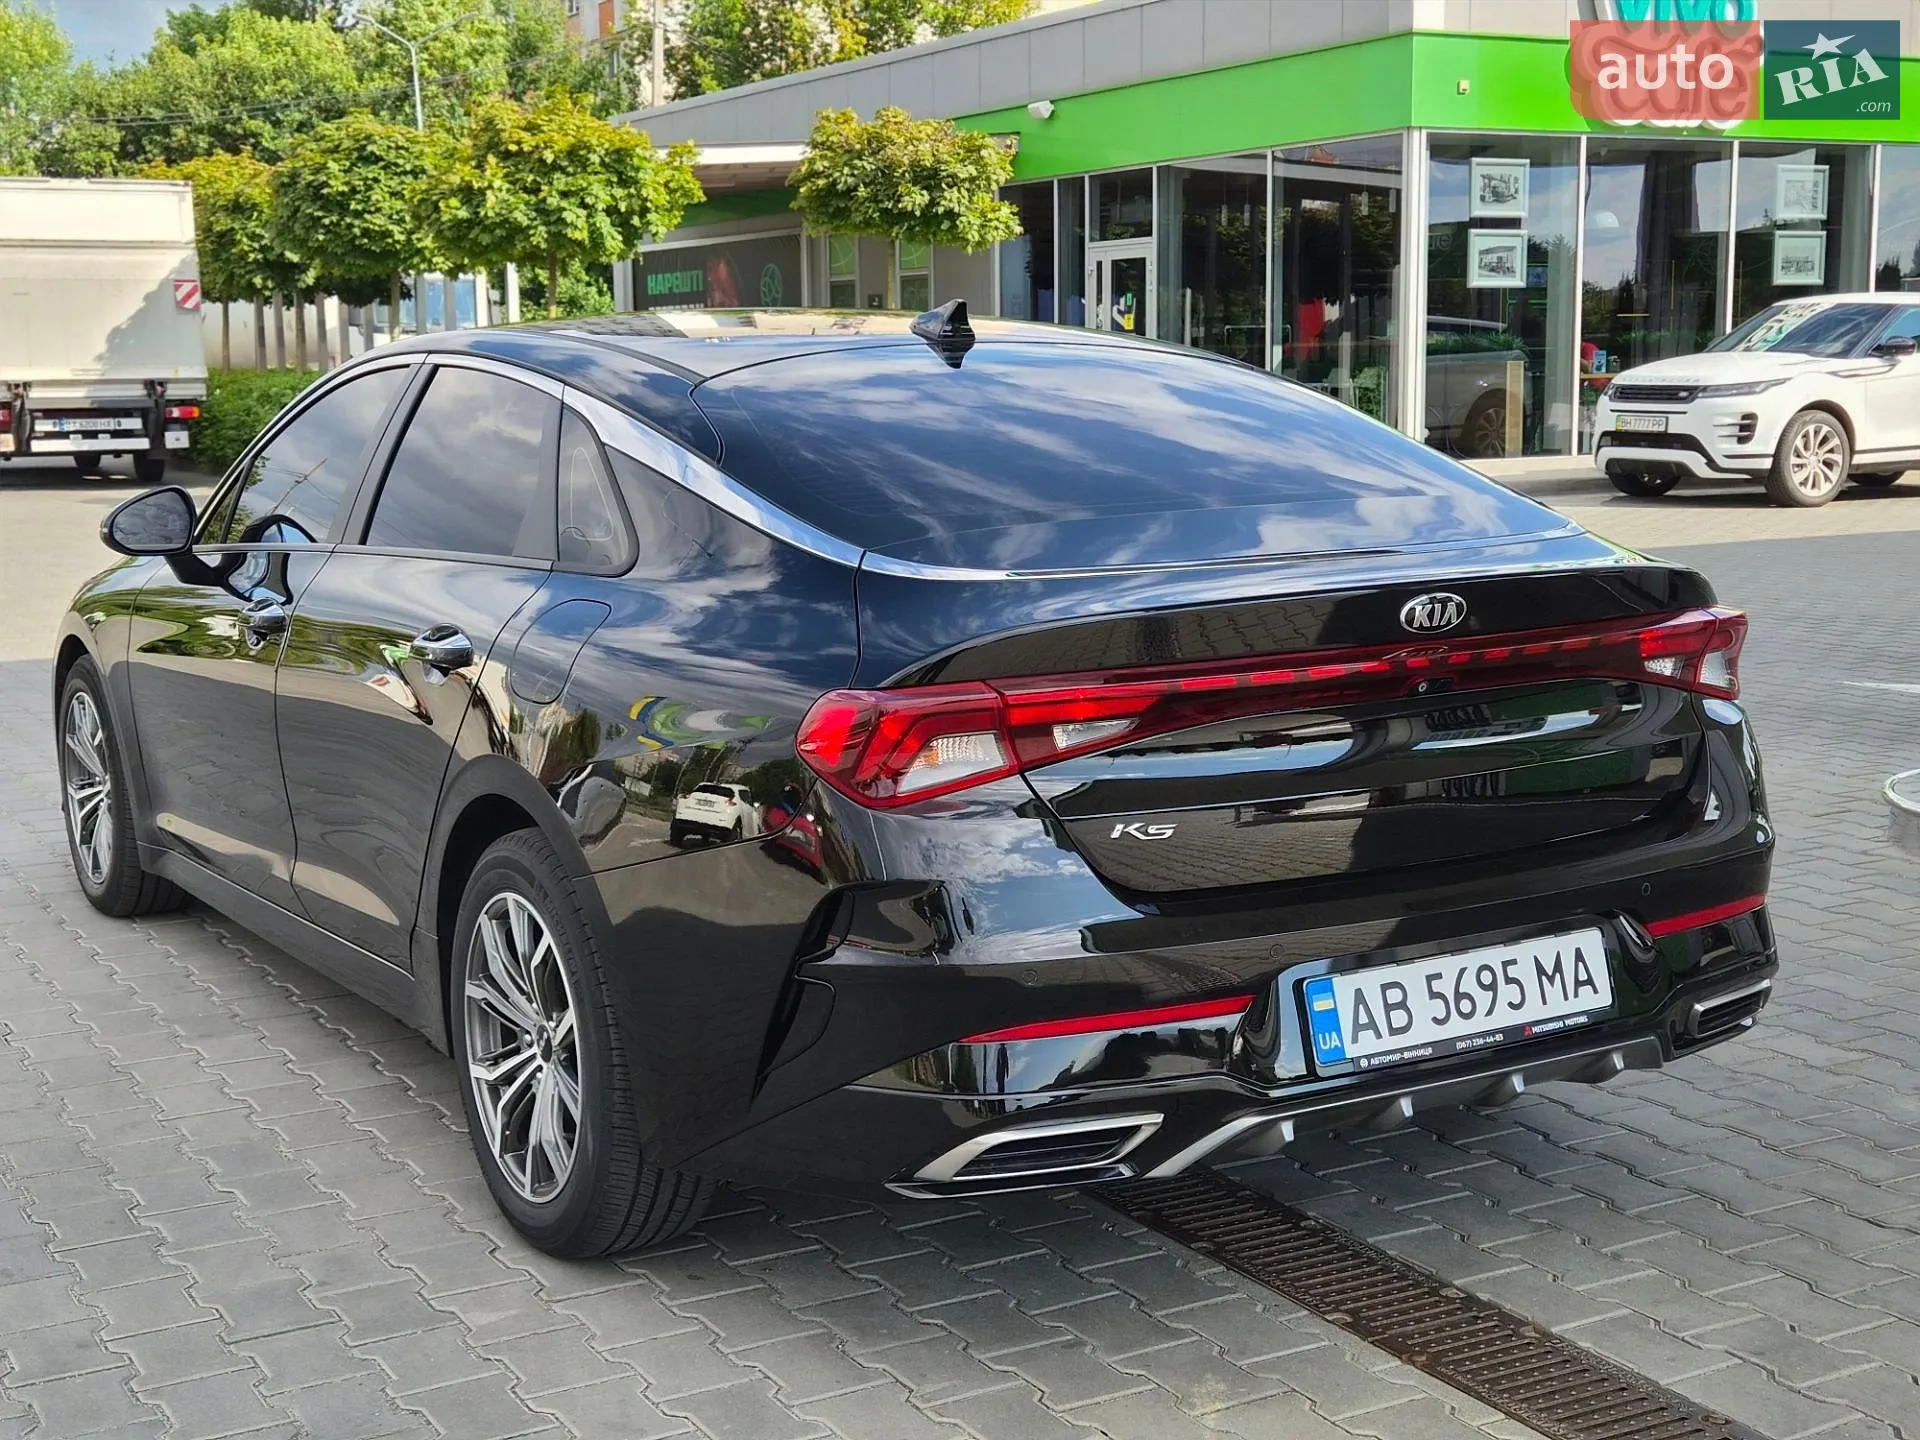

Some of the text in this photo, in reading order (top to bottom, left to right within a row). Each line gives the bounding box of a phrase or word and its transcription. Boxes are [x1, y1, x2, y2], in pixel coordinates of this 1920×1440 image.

[1413, 602, 1457, 627] KIA
[1110, 822, 1178, 840] K5
[1351, 946, 1600, 1044] AB 5695 MA
[1532, 1015, 1588, 1034] MITSUBISHI MOTORS
[1319, 1031, 1341, 1050] UA
[1456, 1039, 1472, 1050] (067)
